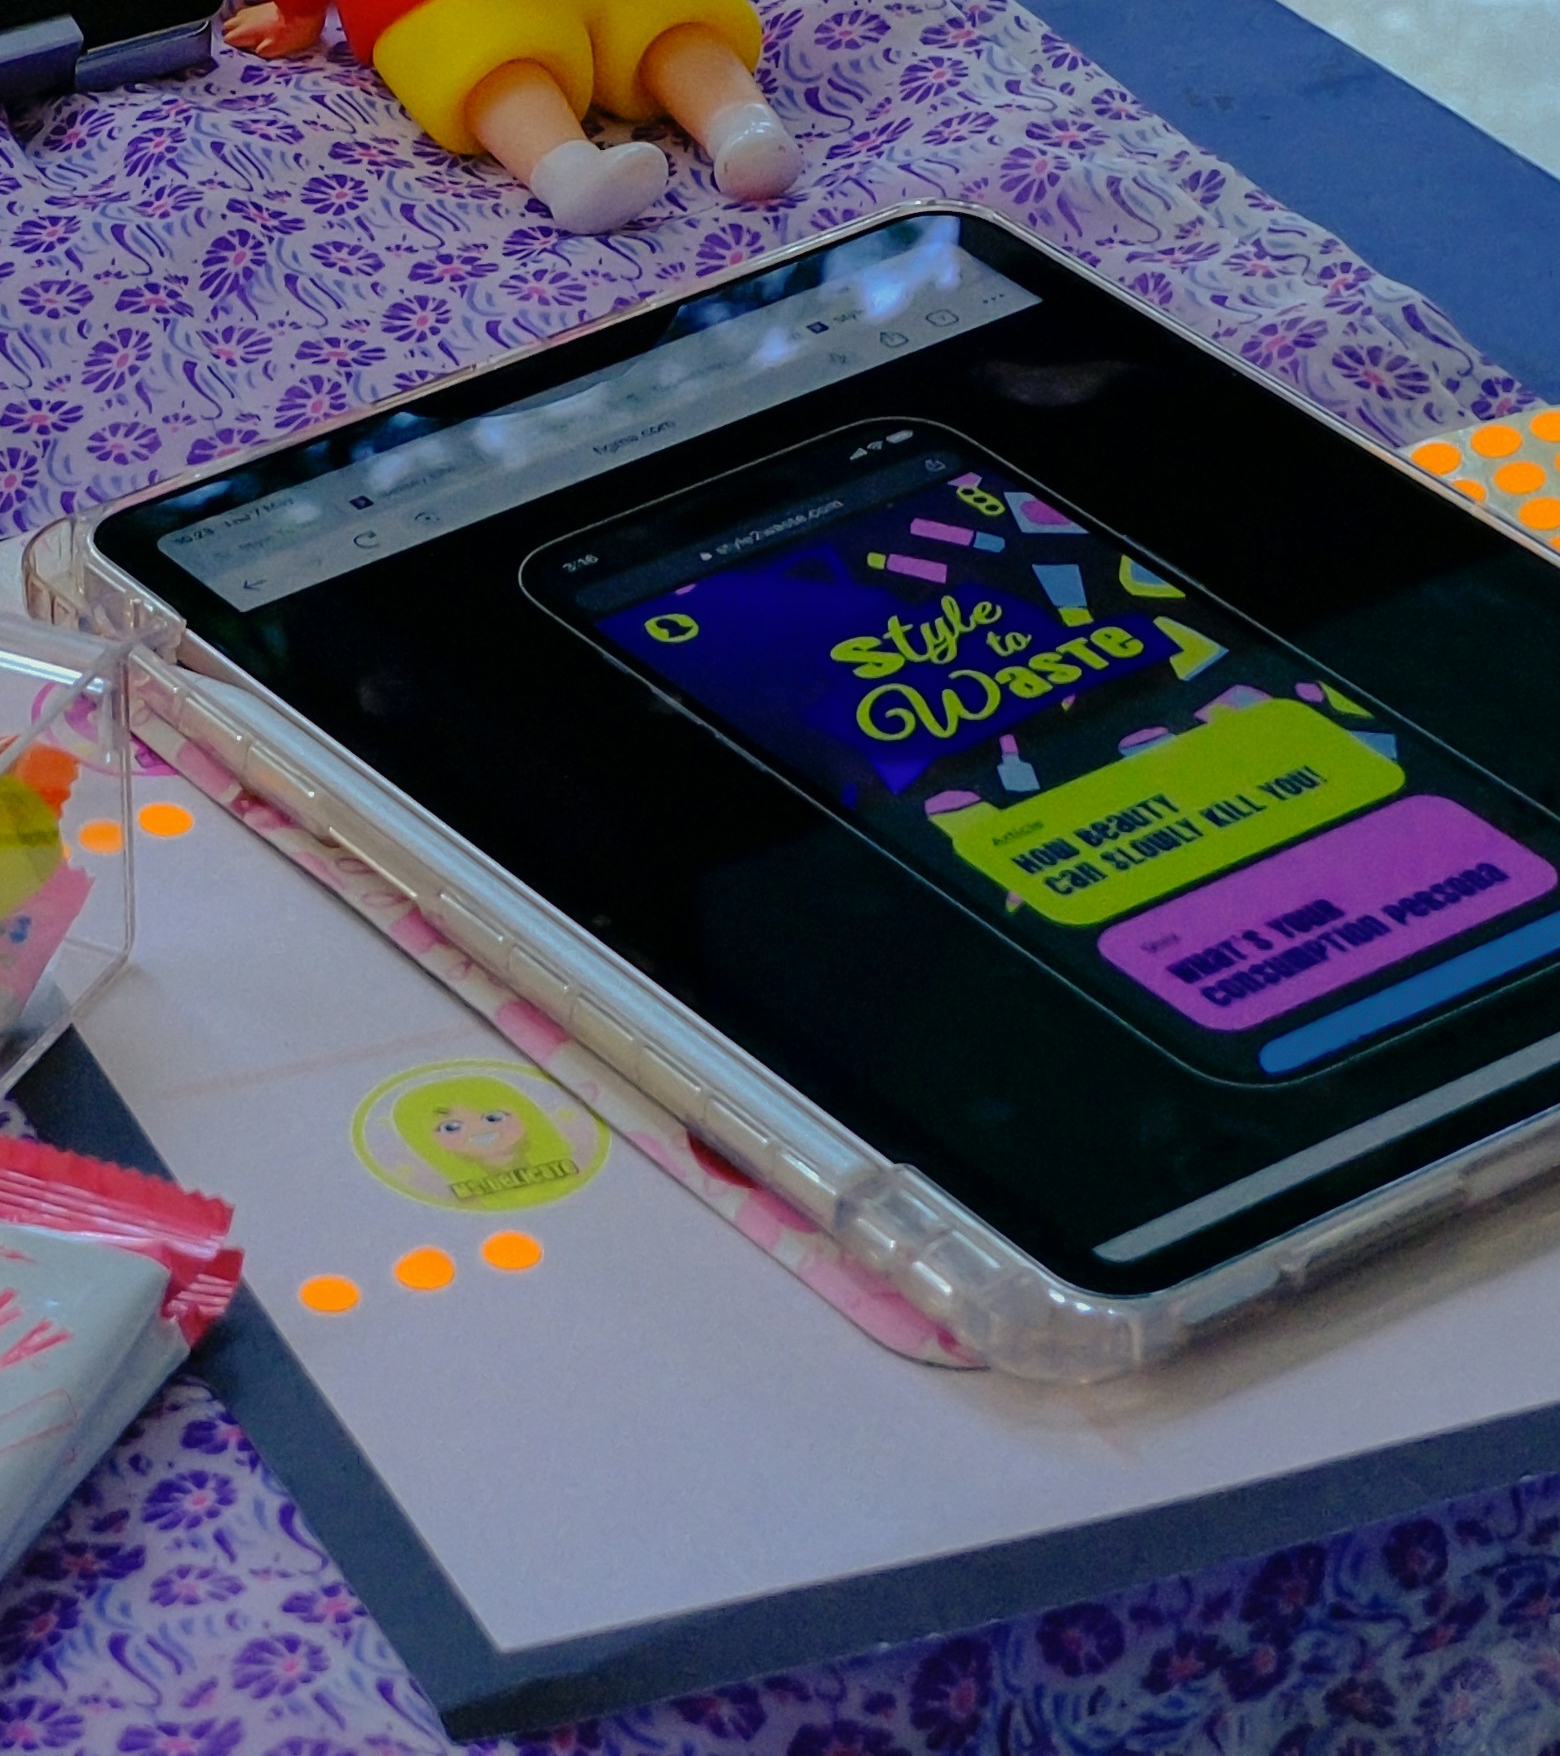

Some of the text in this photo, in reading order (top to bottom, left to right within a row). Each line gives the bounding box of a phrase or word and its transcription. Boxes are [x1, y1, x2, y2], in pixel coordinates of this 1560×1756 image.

[829, 595, 1002, 680] Style
[986, 630, 1032, 658] to
[1011, 792, 1180, 875] HOW BEAUTY
[1099, 817, 1205, 872] SLOWLY
[1199, 794, 1269, 829] KILL
[1256, 764, 1328, 802] YOU!
[1264, 897, 1348, 951] YOUR
[1381, 861, 1511, 928] PERSONA
